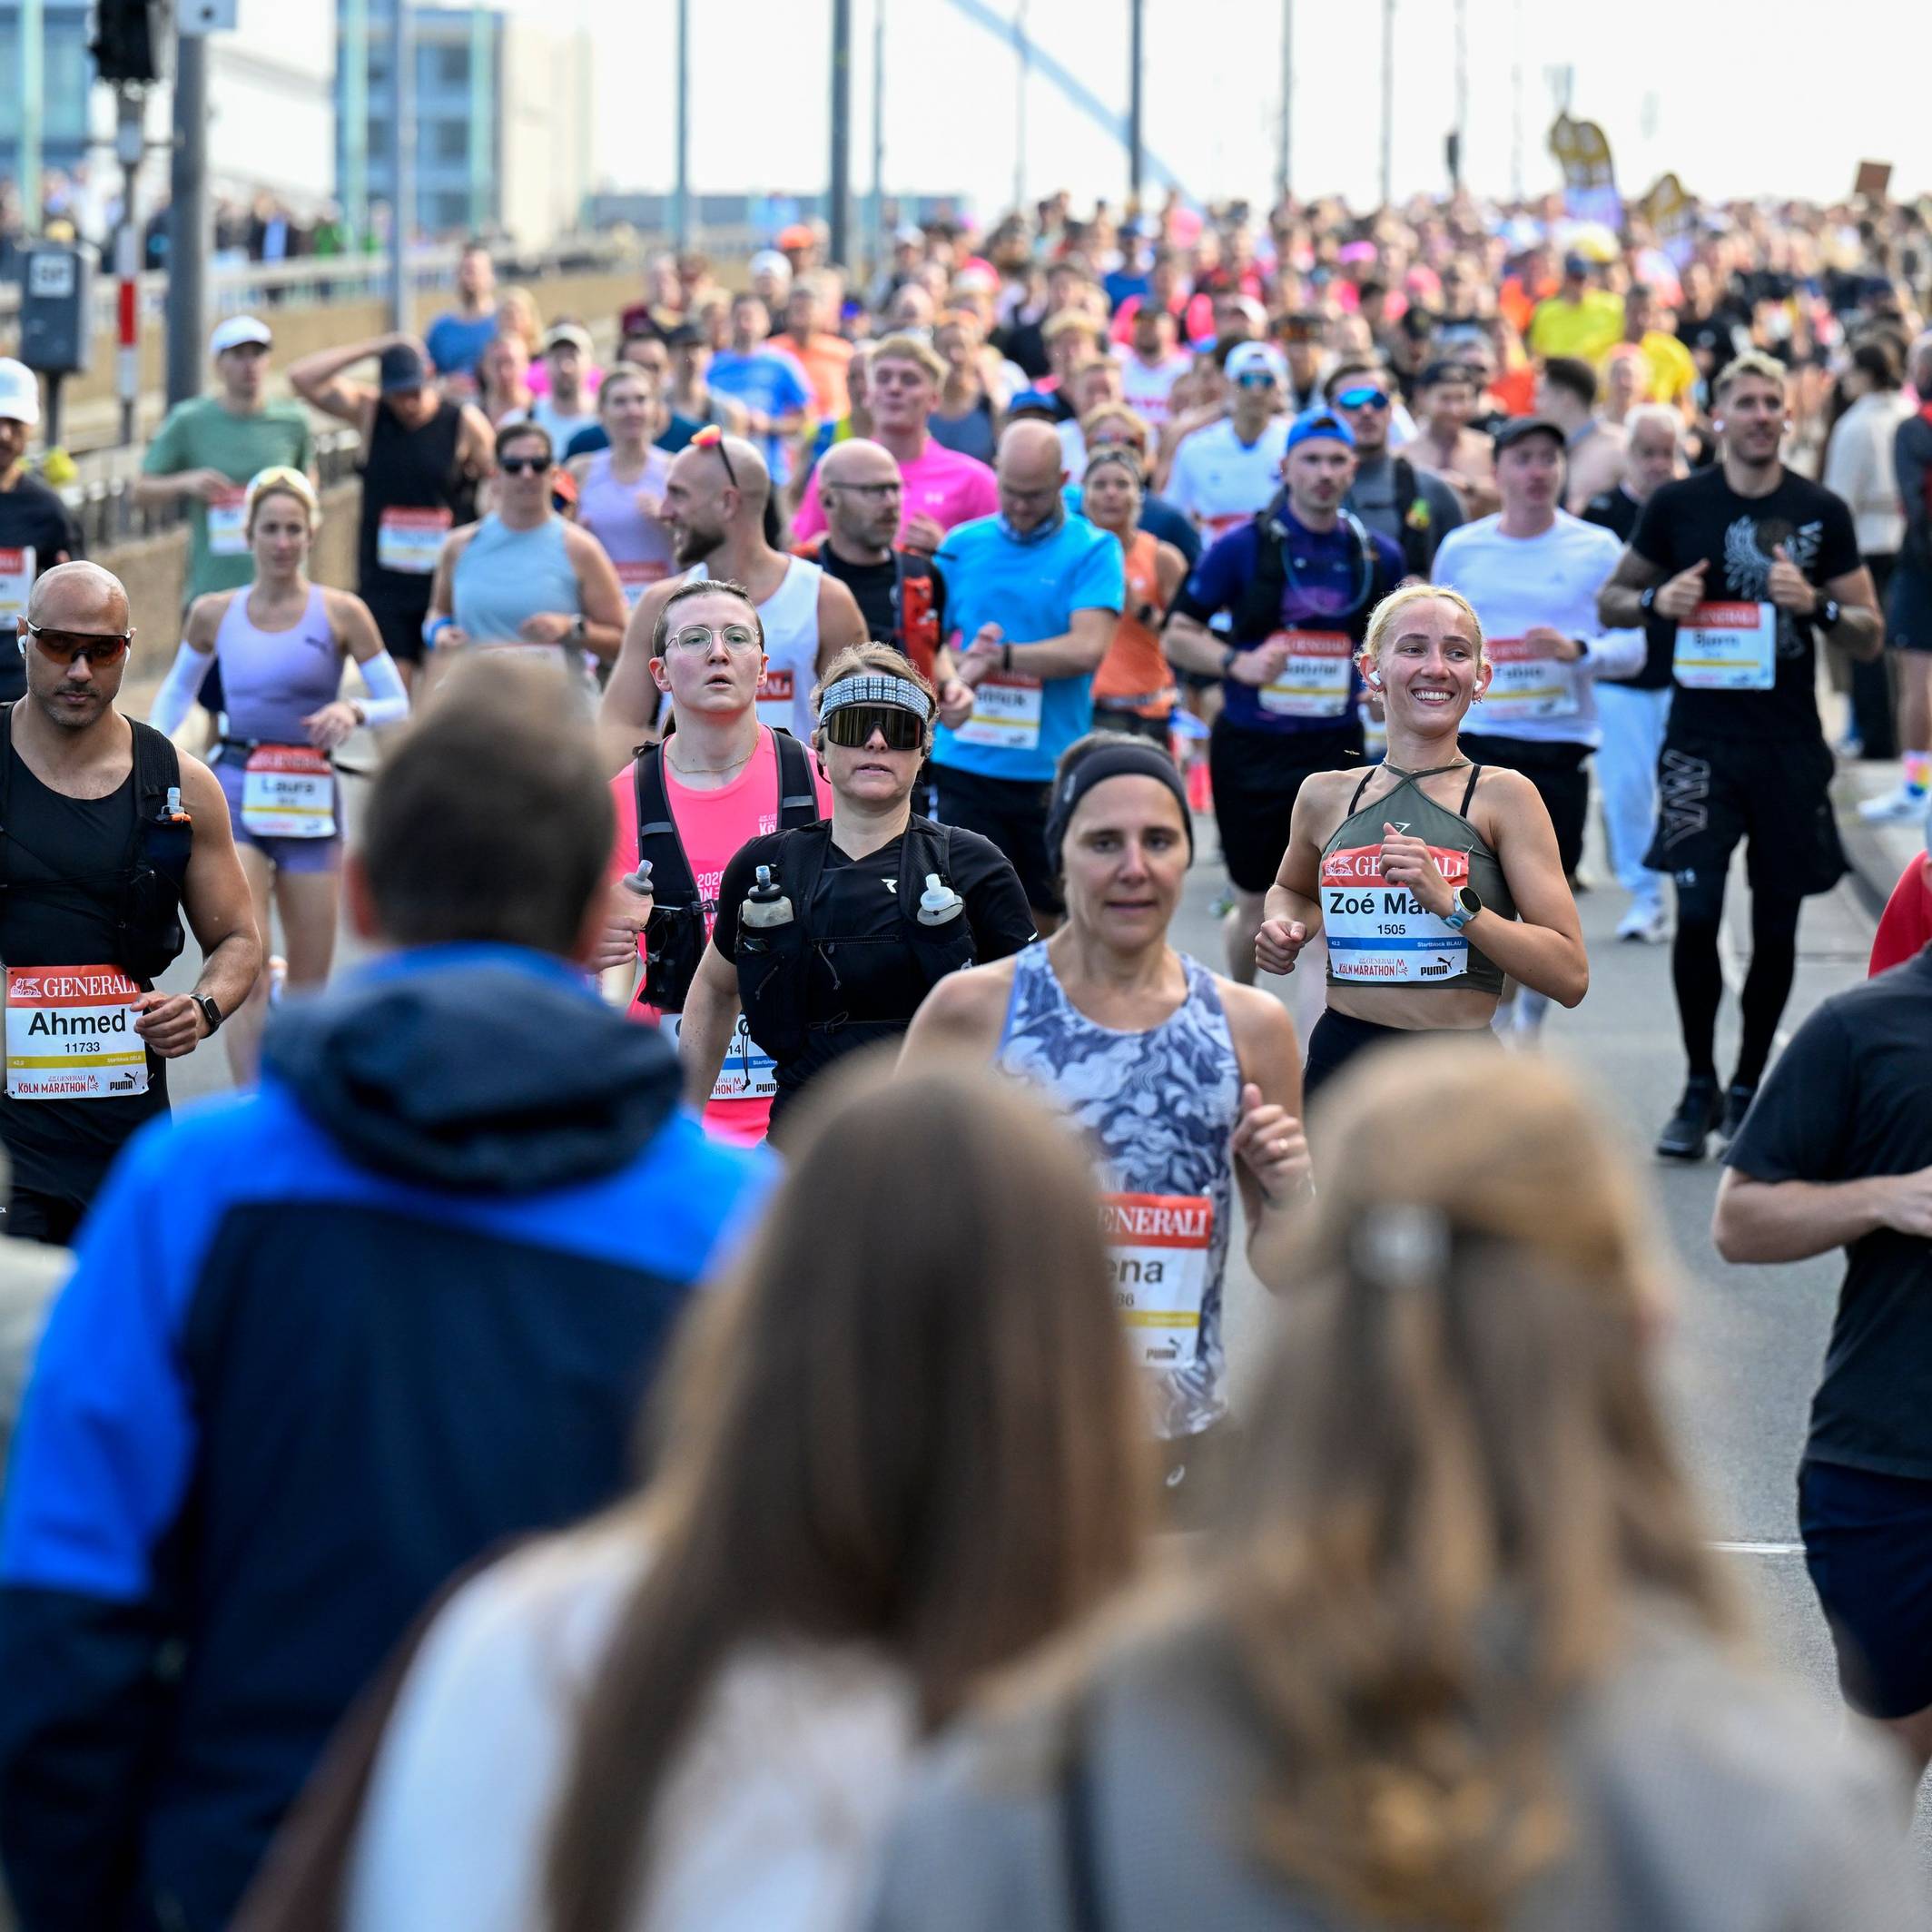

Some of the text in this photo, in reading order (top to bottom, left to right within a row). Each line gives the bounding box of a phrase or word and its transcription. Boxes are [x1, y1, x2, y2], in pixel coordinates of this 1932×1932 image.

[1355, 856, 1463, 877] GEALI
[1329, 892, 1375, 915] Zoé
[1376, 924, 1406, 935] 1505
[1354, 964, 1395, 977] MARATHON
[1420, 965, 1448, 976] PUMA
[43, 974, 138, 998] GENERALI
[28, 1008, 126, 1036] Ahmed
[64, 1041, 100, 1053] 11733
[41, 1081, 86, 1093] MARATHON
[110, 1080, 133, 1090] PUMA
[755, 1082, 776, 1093] PUM
